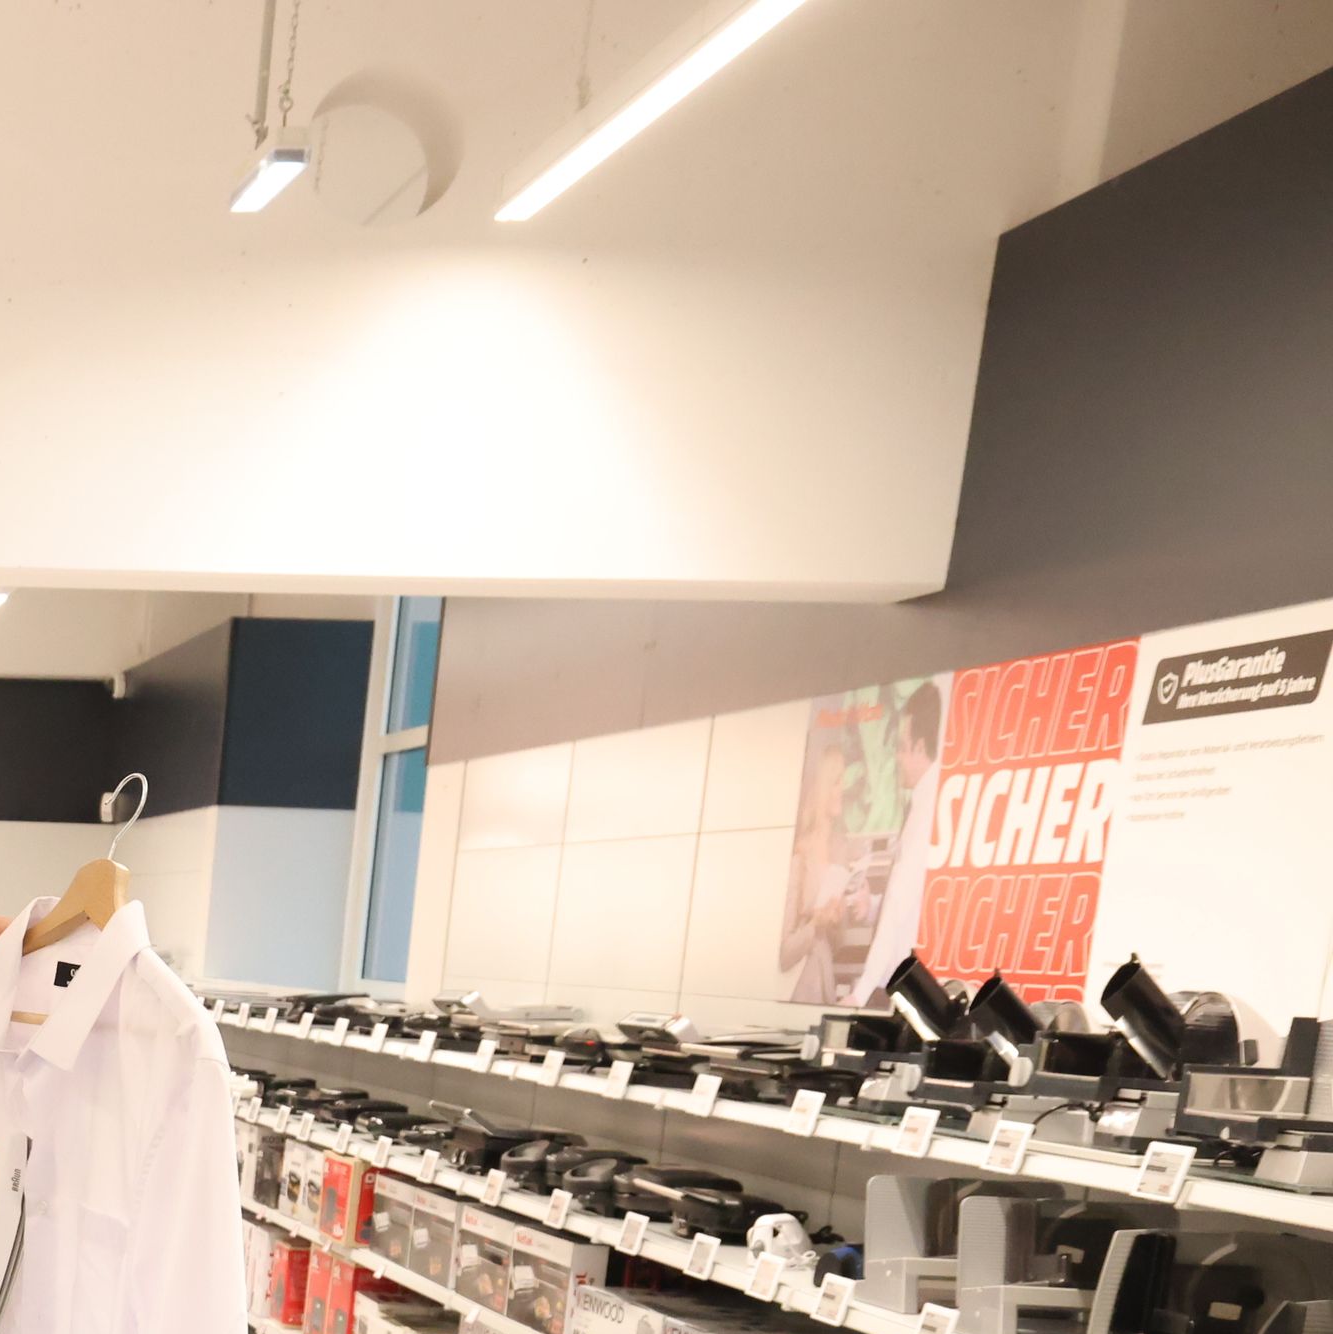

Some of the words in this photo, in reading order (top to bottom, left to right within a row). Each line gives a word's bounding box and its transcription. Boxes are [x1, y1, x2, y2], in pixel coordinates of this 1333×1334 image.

[941, 641, 1138, 769] SICHER
[1181, 647, 1286, 687] PlusGarantie
[929, 758, 1121, 870] SICHER
[914, 872, 1100, 978] SICHER
[576, 1288, 625, 1325] KENWOOD
